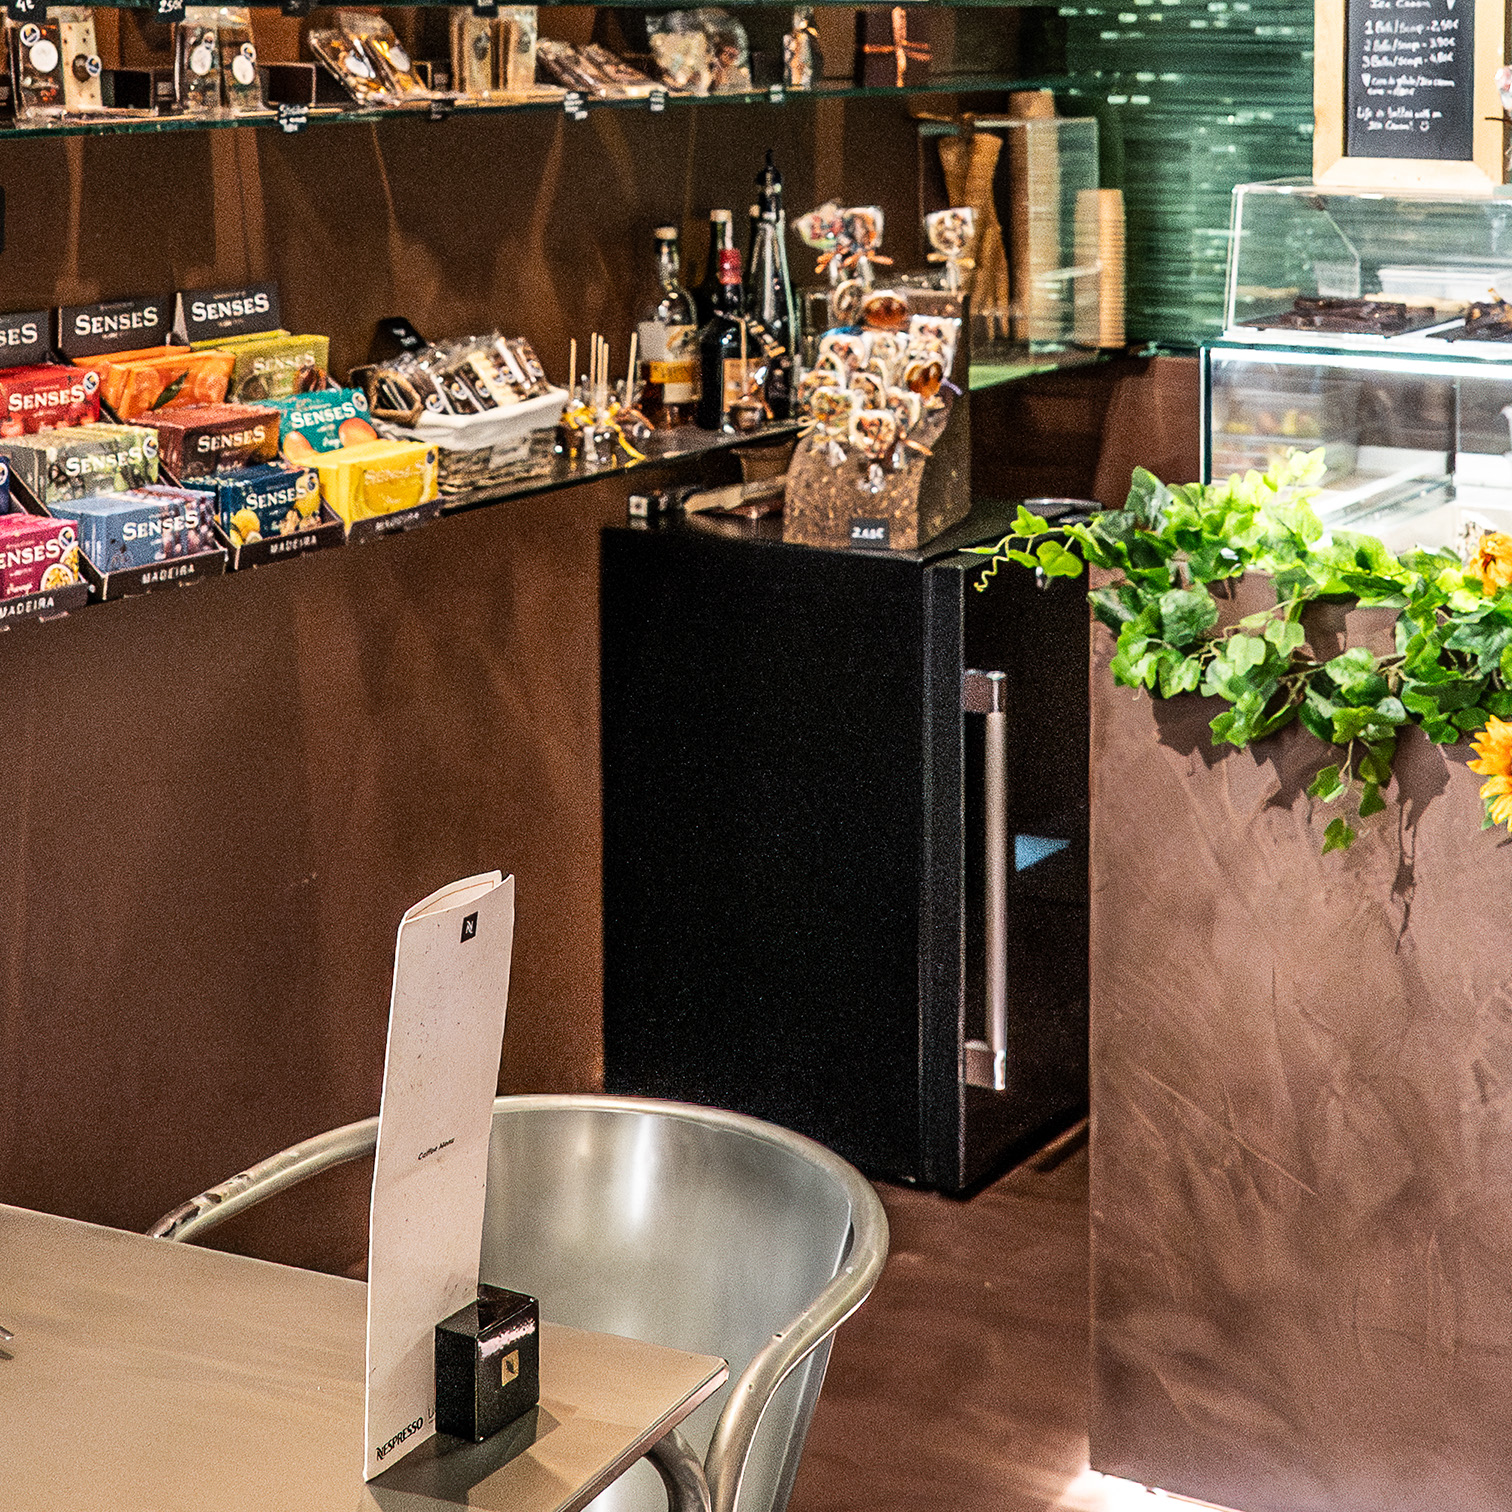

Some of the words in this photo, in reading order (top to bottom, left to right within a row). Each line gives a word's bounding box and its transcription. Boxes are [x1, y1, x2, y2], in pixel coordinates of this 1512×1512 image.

[74, 306, 159, 336] SENSES
[190, 292, 270, 322] SENSES
[8, 385, 85, 412] SENSES
[290, 401, 356, 429] SENSES
[197, 425, 266, 453] SENSES
[66, 446, 144, 477] SENSES
[245, 488, 307, 511] SENSES
[123, 510, 200, 541] SENSES
[141, 563, 196, 585] MADEIRA
[375, 1416, 424, 1462] NESPRESSO
